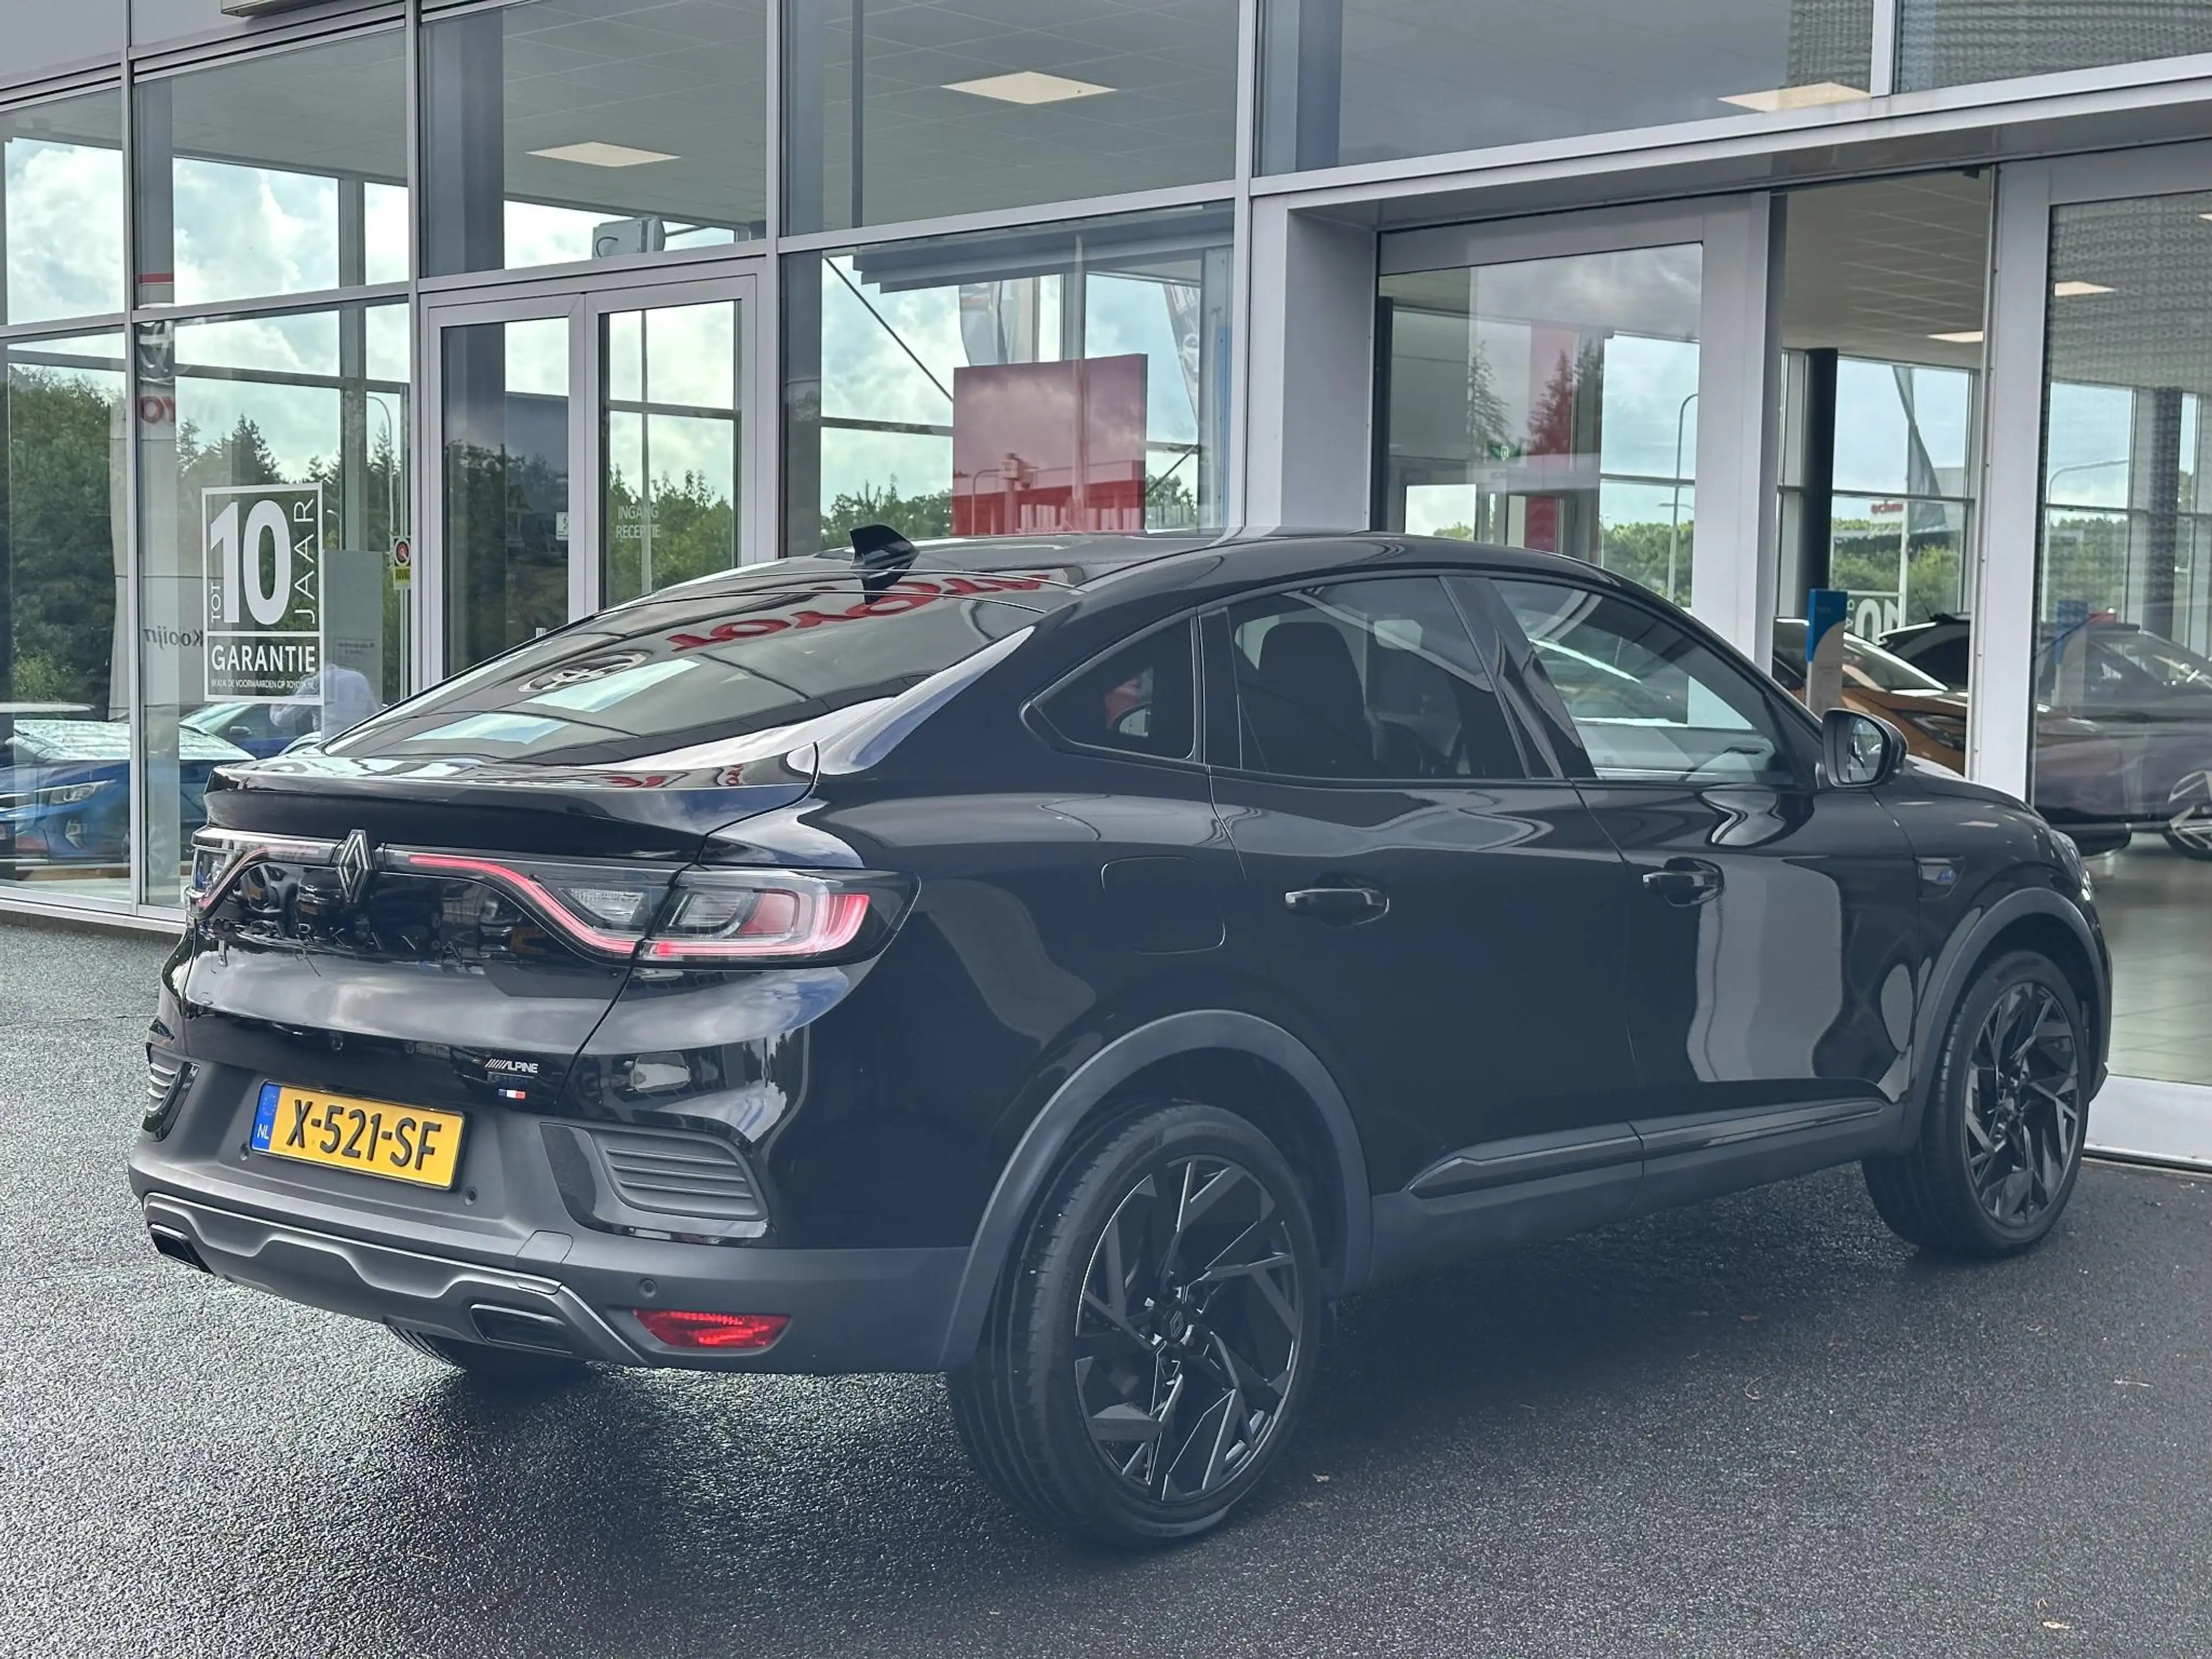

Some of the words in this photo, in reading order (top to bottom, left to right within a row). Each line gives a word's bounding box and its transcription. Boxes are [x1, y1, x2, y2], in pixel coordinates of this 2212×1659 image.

[618, 504, 659, 520] INGANG
[210, 499, 291, 625] 10
[293, 498, 316, 624] JAAR
[211, 581, 221, 623] TOT
[211, 645, 316, 672] GARANTIE
[501, 1060, 539, 1073] ALPINE
[257, 1123, 270, 1140] NL
[285, 1099, 442, 1171] X-521-SF
